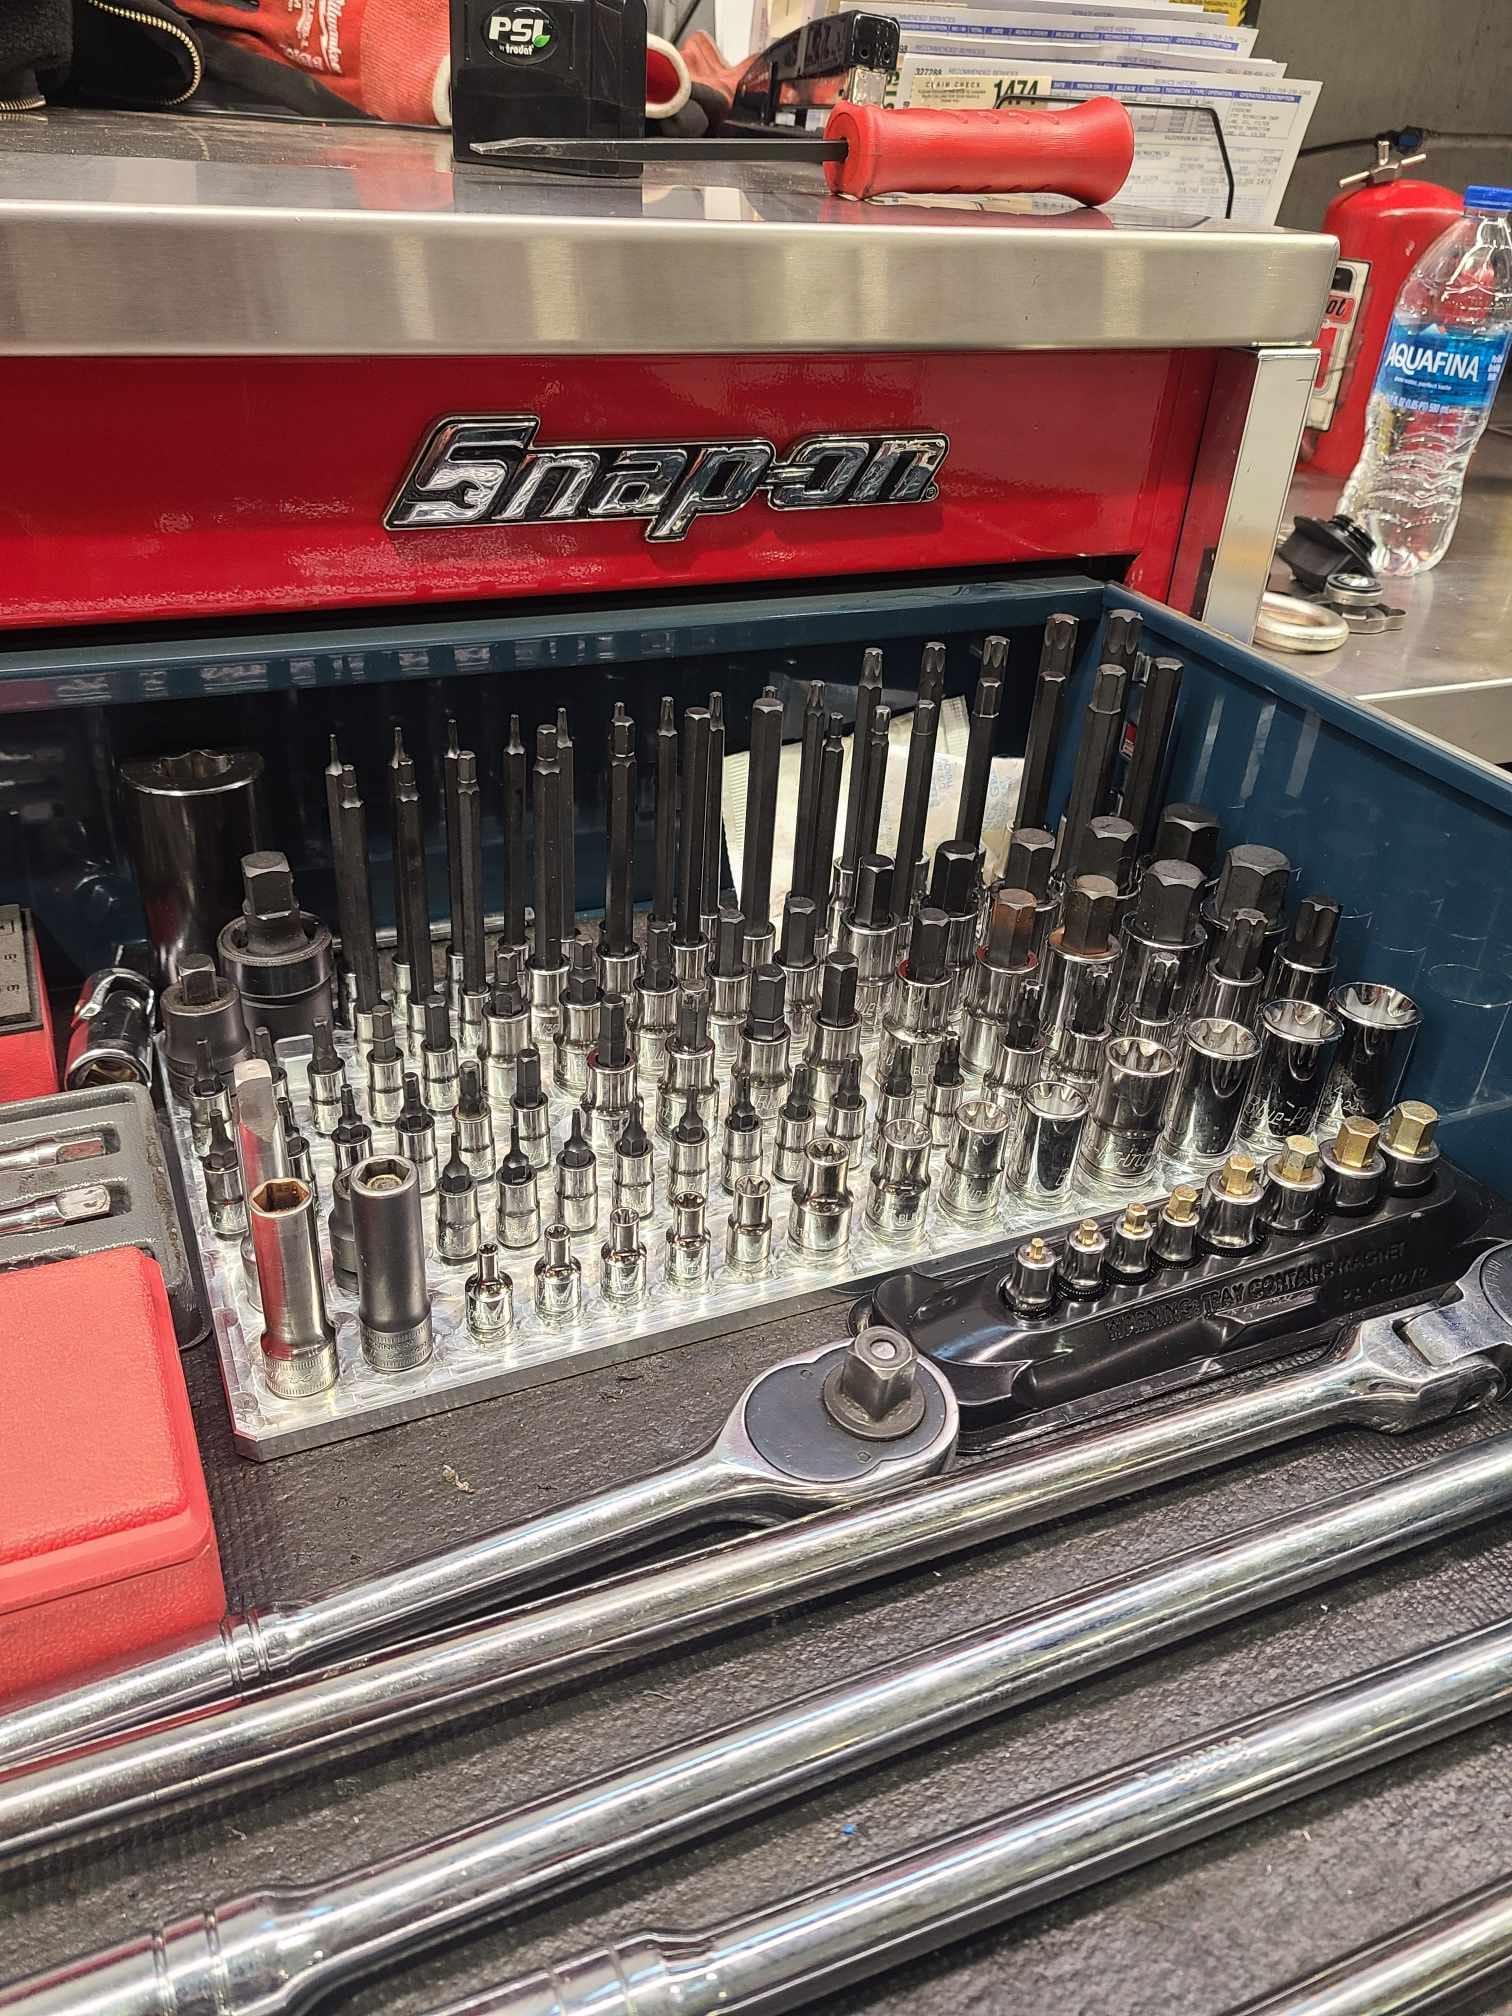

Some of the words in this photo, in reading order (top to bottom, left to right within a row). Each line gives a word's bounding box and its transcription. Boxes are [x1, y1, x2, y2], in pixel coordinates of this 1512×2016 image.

[488, 16, 544, 42] PSI
[1385, 341, 1480, 383] AQUAFINA
[387, 414, 947, 541] Snap-on
[1202, 1280, 1247, 1317] TRAY
